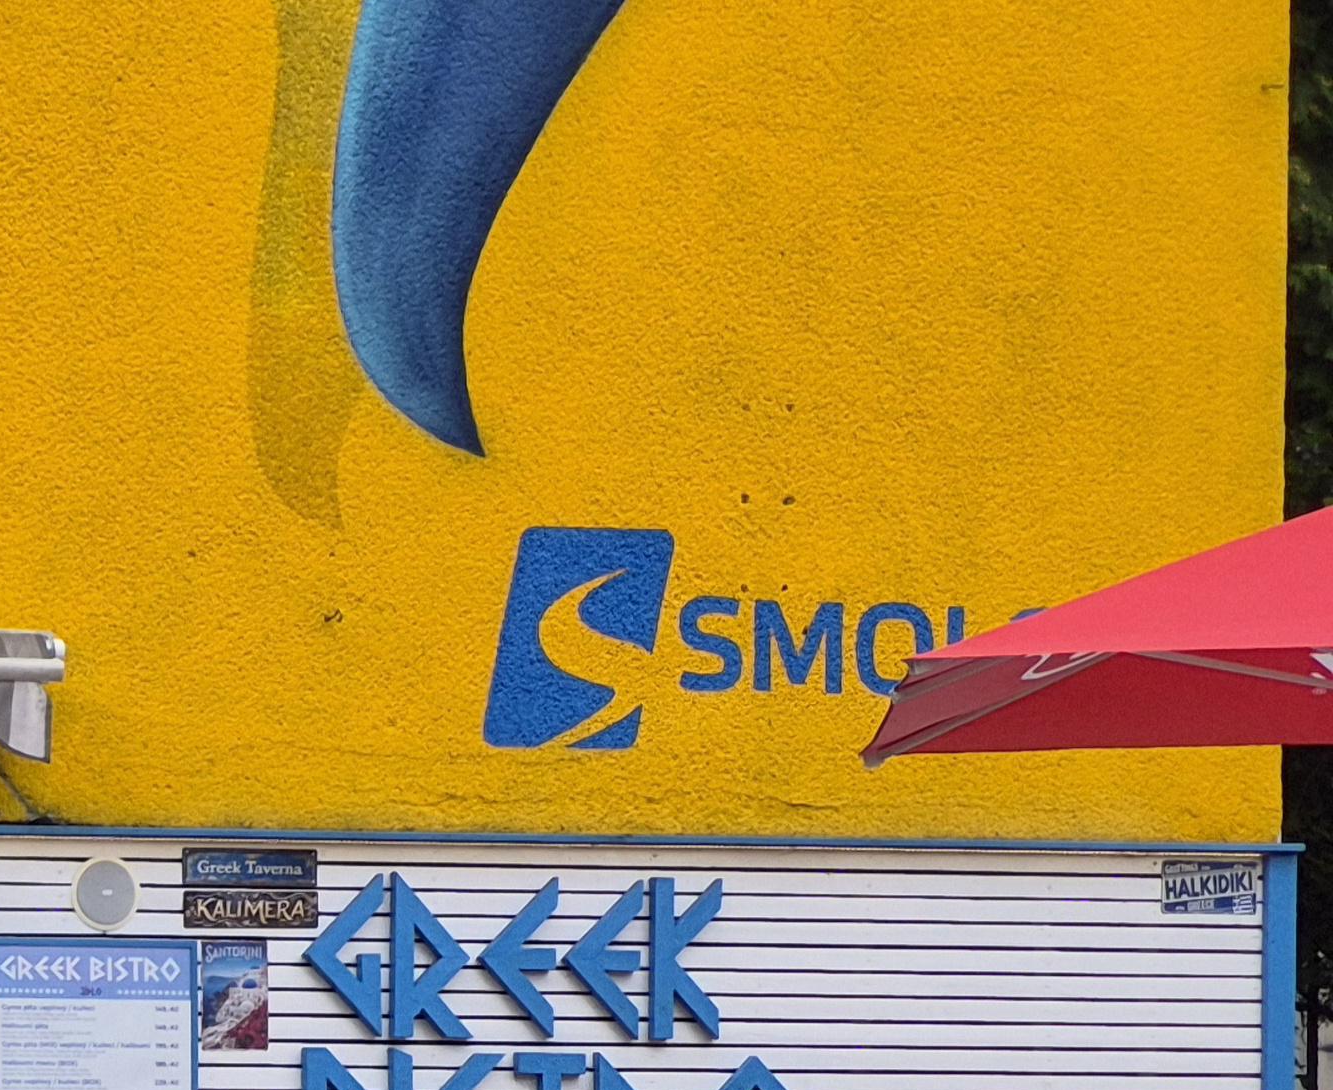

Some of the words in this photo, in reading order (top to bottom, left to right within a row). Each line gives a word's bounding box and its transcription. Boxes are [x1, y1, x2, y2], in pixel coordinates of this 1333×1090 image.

[197, 859, 241, 874] Greek
[245, 860, 303, 875] Taverna
[1165, 871, 1253, 900] HALKIDIKI
[196, 897, 305, 924] KALIMERA
[205, 944, 263, 963] SANTORINI
[301, 870, 723, 1041] GREEK
[0, 955, 81, 981] GREEK
[90, 956, 181, 982] BISTRO
